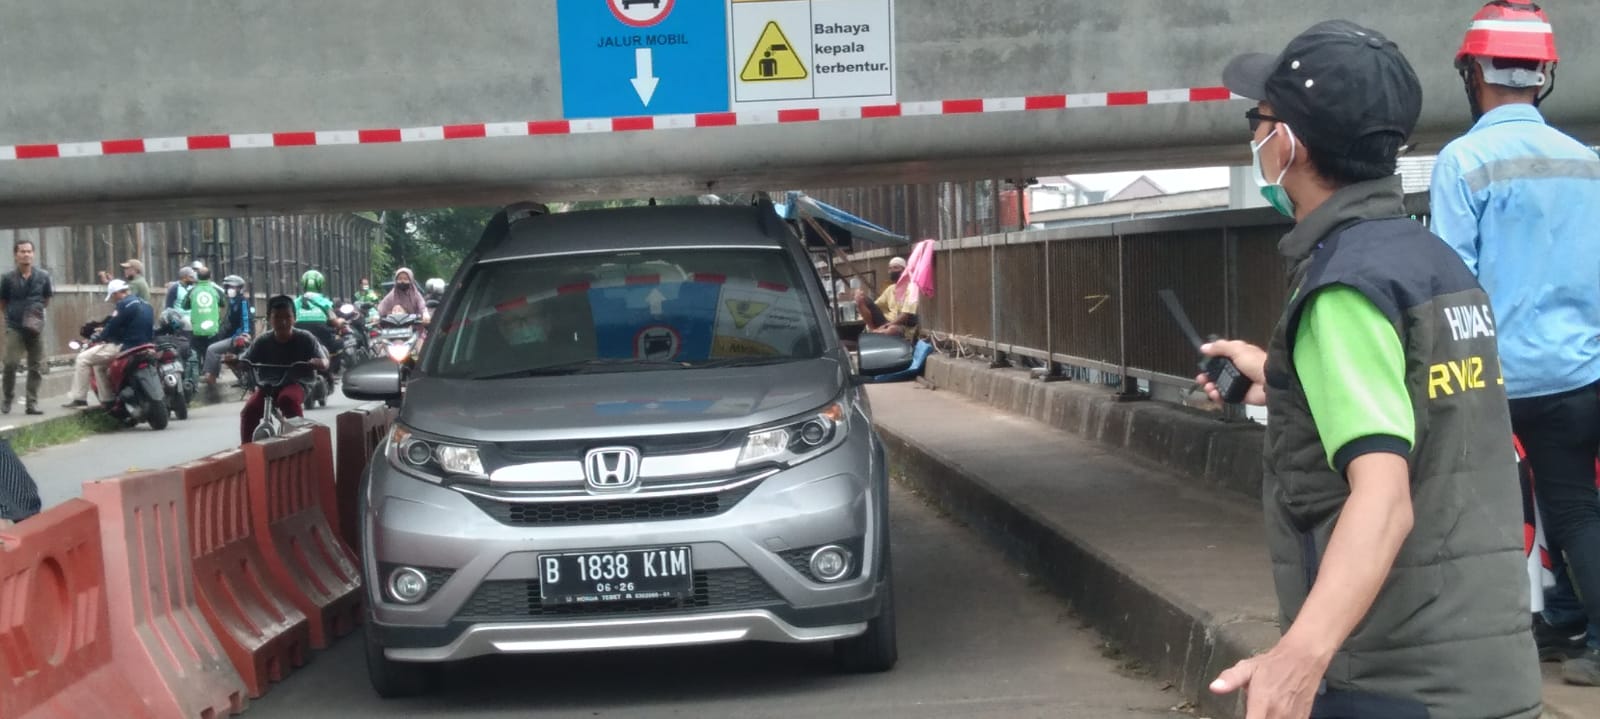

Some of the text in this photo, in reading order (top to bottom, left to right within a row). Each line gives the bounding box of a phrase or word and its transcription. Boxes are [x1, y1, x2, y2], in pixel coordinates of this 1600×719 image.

[814, 22, 870, 36] Bahaya
[597, 33, 688, 48] JALUR MOBIL
[814, 41, 865, 56] kepala
[815, 61, 889, 74] terbentur.
[545, 549, 687, 584] B 1838 KIM
